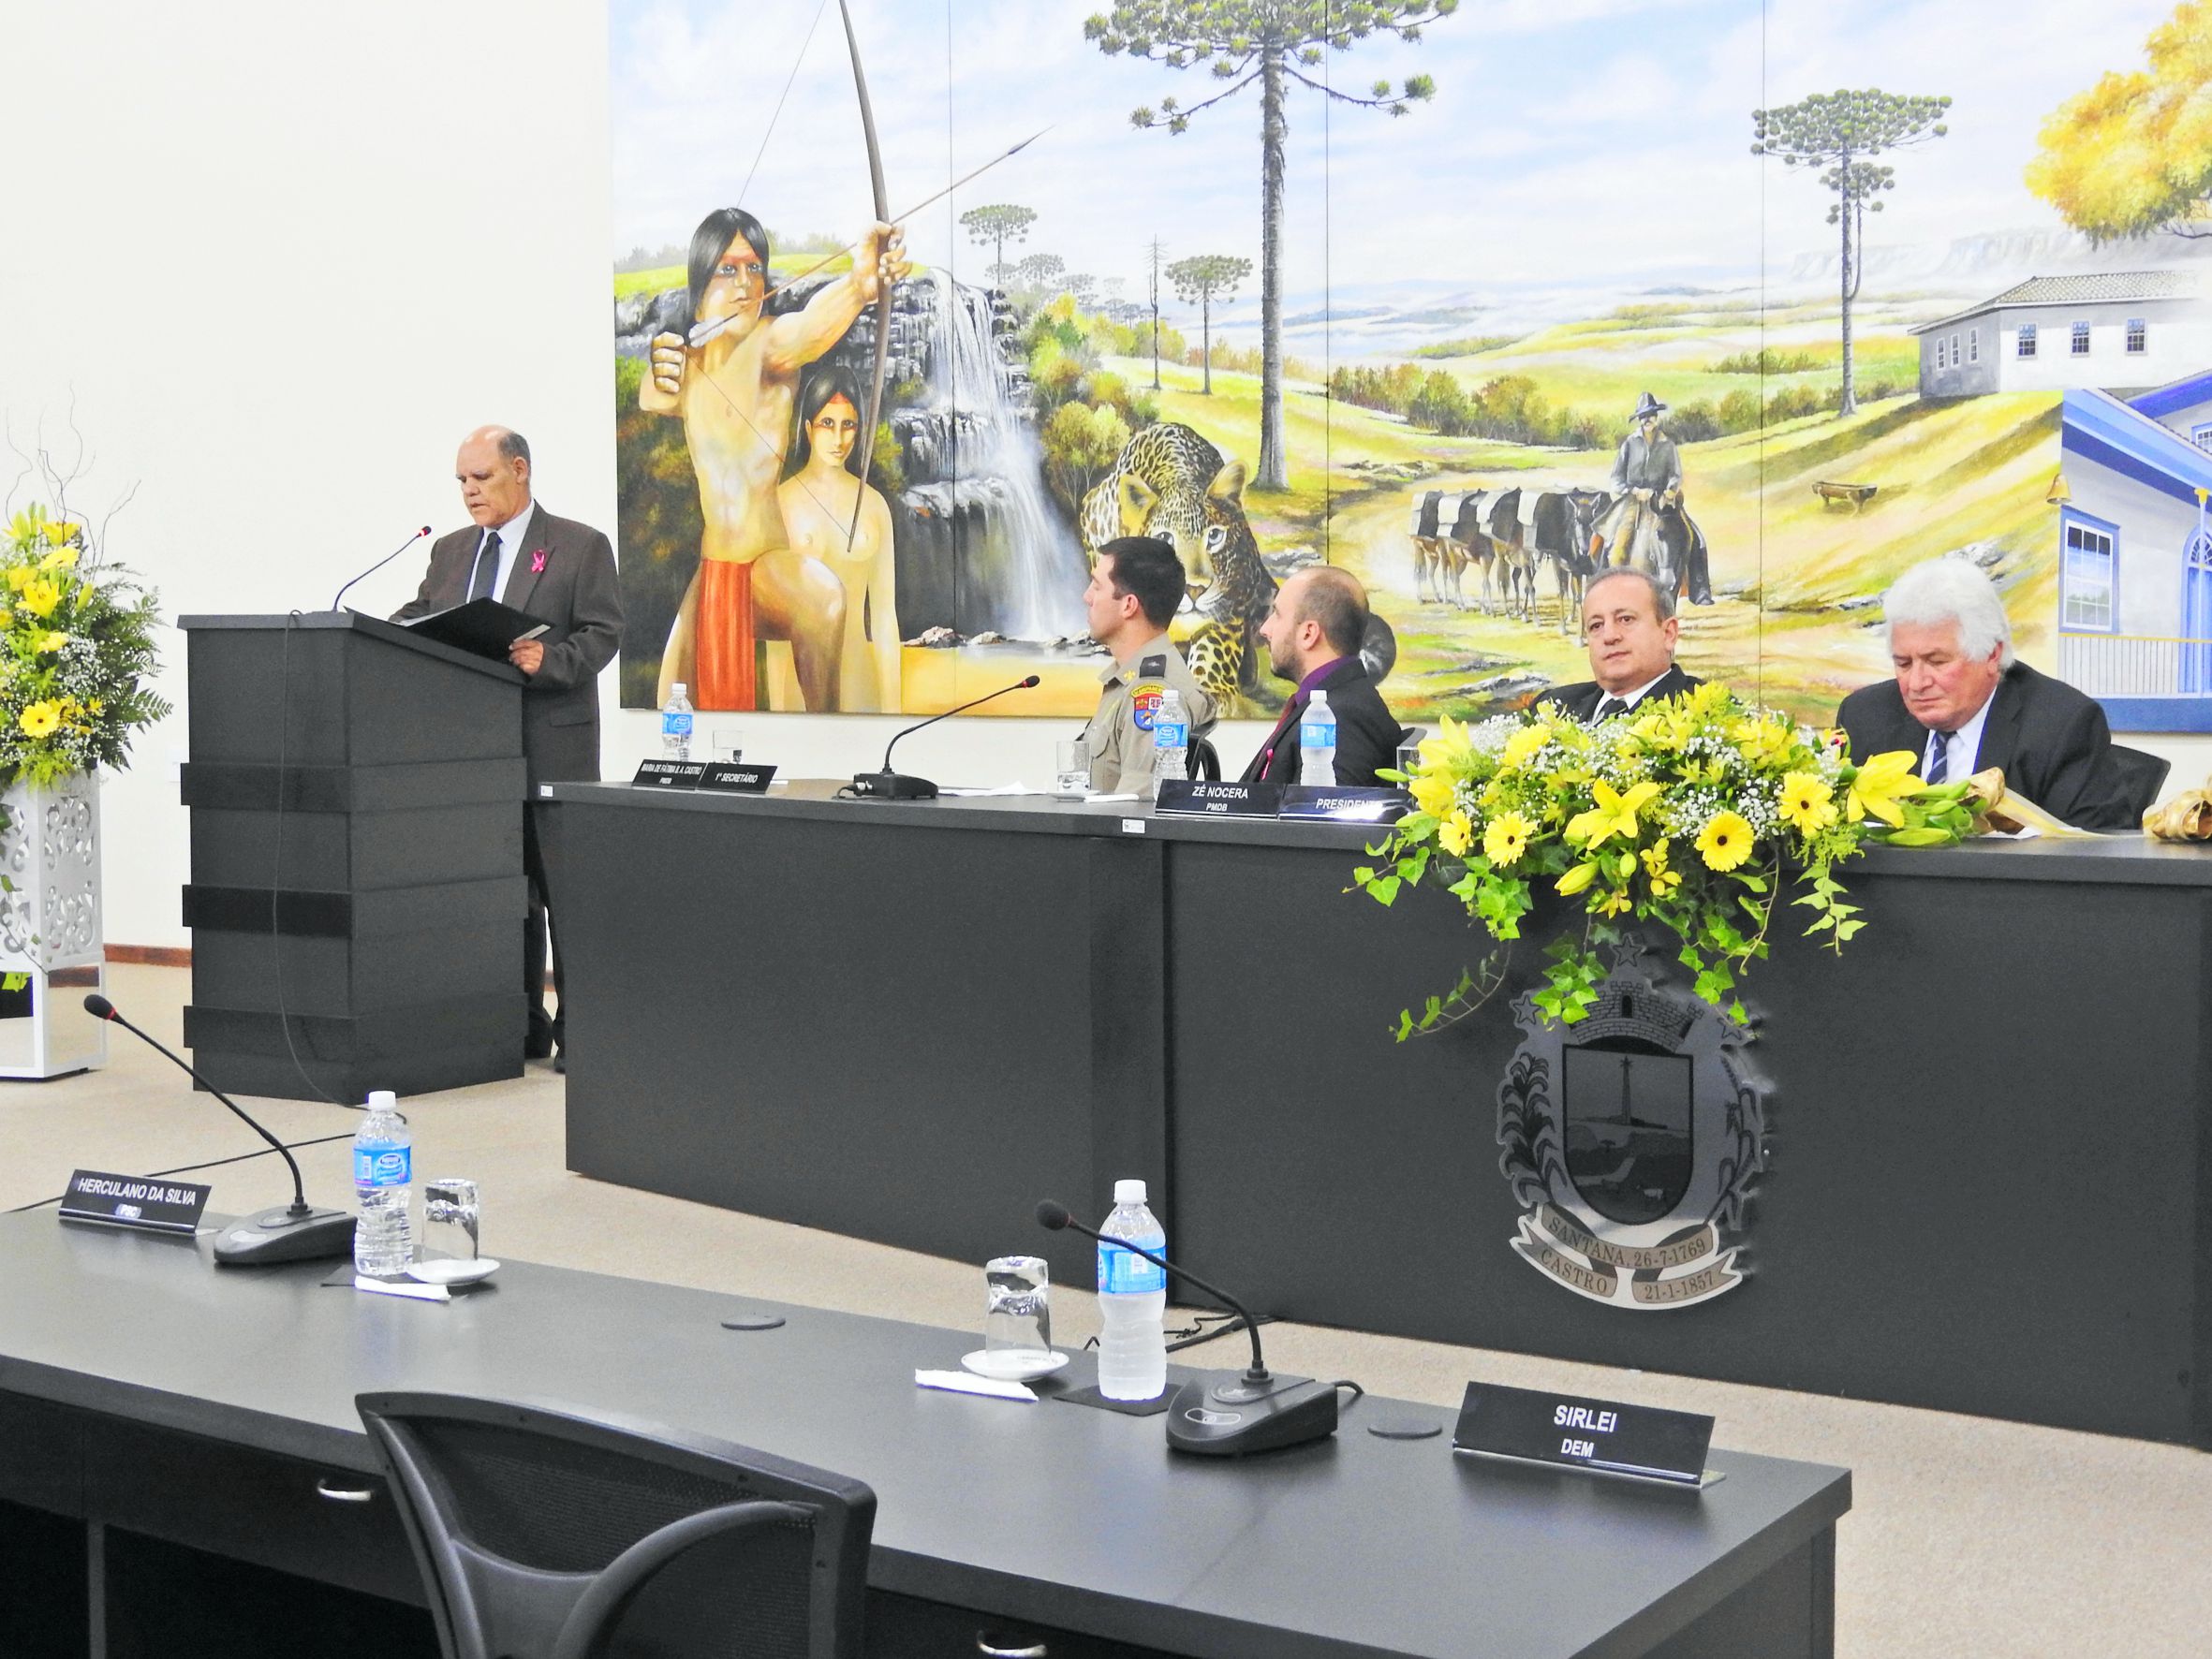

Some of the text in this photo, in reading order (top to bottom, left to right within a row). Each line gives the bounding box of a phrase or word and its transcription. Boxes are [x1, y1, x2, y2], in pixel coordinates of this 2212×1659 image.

[721, 771, 759, 784] SECRETÁRIO
[1191, 784, 1248, 799] ZÉ NOCERA
[1205, 802, 1228, 812] PMDB
[1315, 798, 1381, 810] PRESIDEN
[77, 1177, 197, 1206] HERCULANO DA SILVA
[119, 1203, 139, 1217] PSC
[1541, 1249, 1608, 1294] CASTRO
[1644, 1270, 1715, 1300] 21-1-1857
[1554, 1404, 1617, 1432] SIRLEI
[1560, 1438, 1595, 1458] DEM
